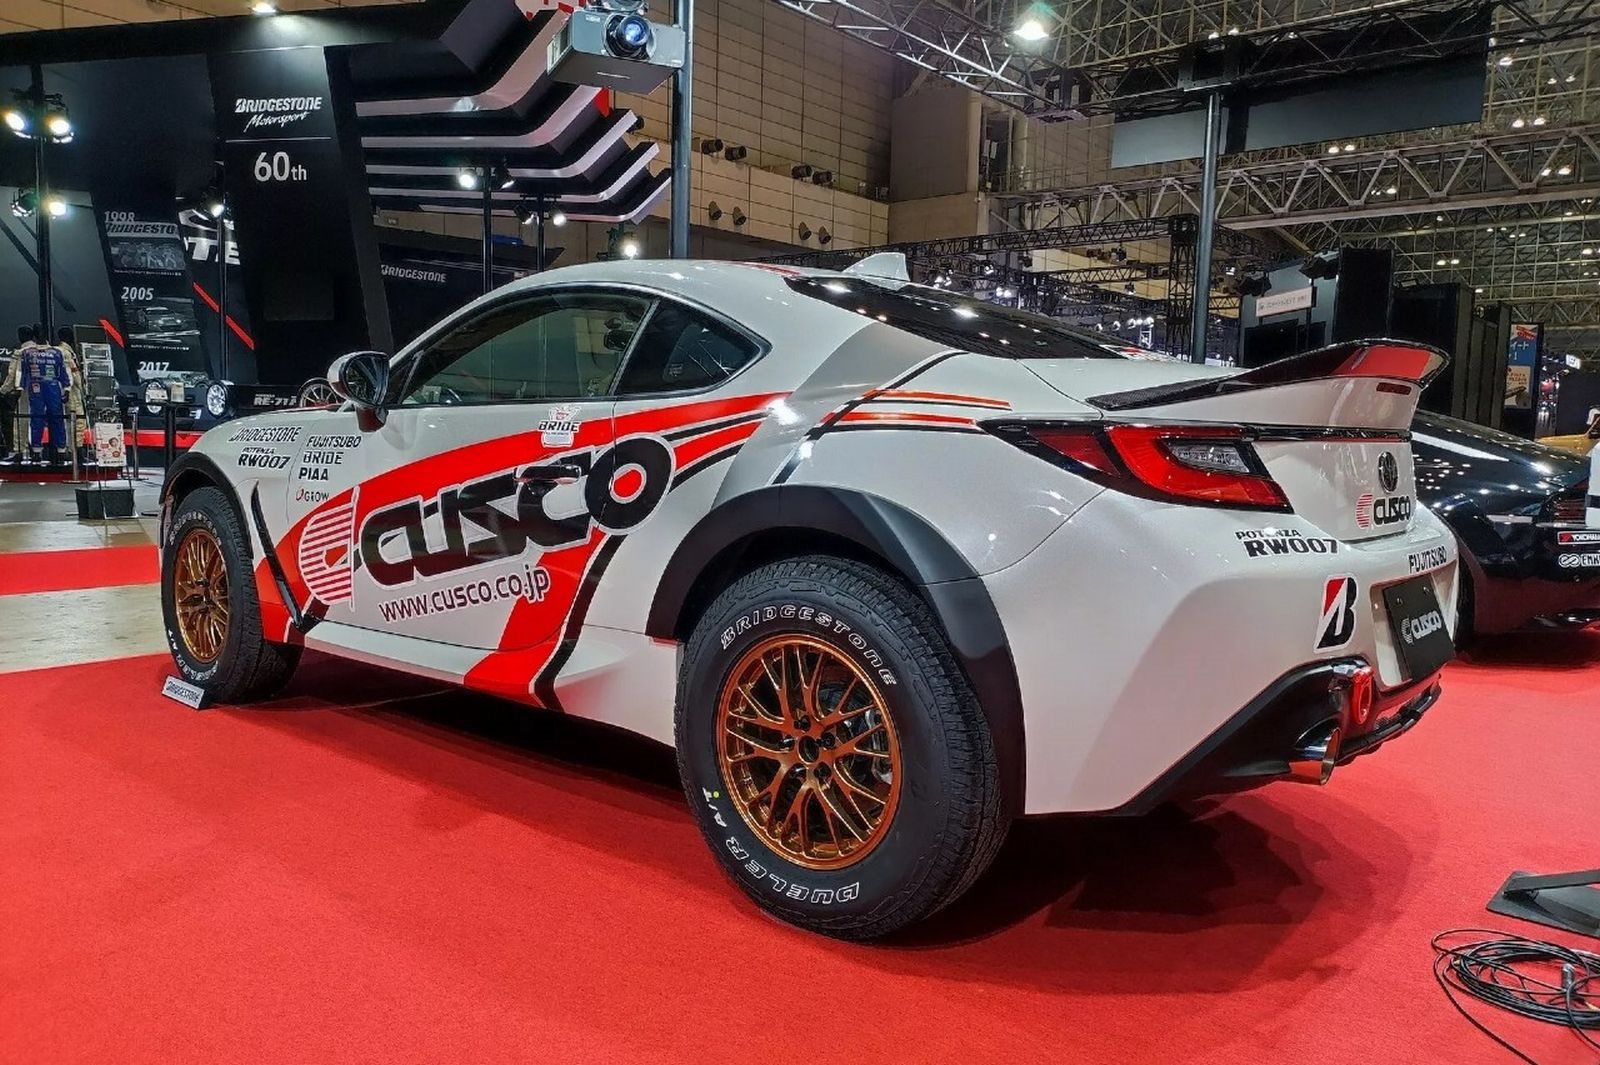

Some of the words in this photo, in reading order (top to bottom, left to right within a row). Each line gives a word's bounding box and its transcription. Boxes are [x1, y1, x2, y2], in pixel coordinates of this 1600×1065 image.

[235, 97, 322, 114] BRIDGESTONE
[243, 111, 310, 133] Motorsport
[254, 152, 307, 182] 60th
[381, 264, 447, 283] BRIDGESTONE
[121, 286, 154, 300] 2005
[139, 361, 170, 371] 2017
[228, 427, 302, 442] BRIDGESTONE
[539, 420, 580, 432] BRIDE
[306, 436, 361, 448] FUJITSUBO
[238, 454, 291, 469] RW007
[303, 451, 344, 464] BRIDE
[299, 467, 328, 480] PIAA
[361, 436, 675, 588] CUSCO
[1373, 496, 1411, 526] CUSCO
[1243, 539, 1338, 558] RW007
[1409, 546, 1447, 573] FUJITSUBO
[378, 564, 549, 621] www.cusco.co.jp
[1411, 611, 1442, 639] CUSCO
[720, 604, 897, 686] BRIDGESTONE
[702, 787, 727, 827] A/T
[725, 836, 860, 905] DUELER
